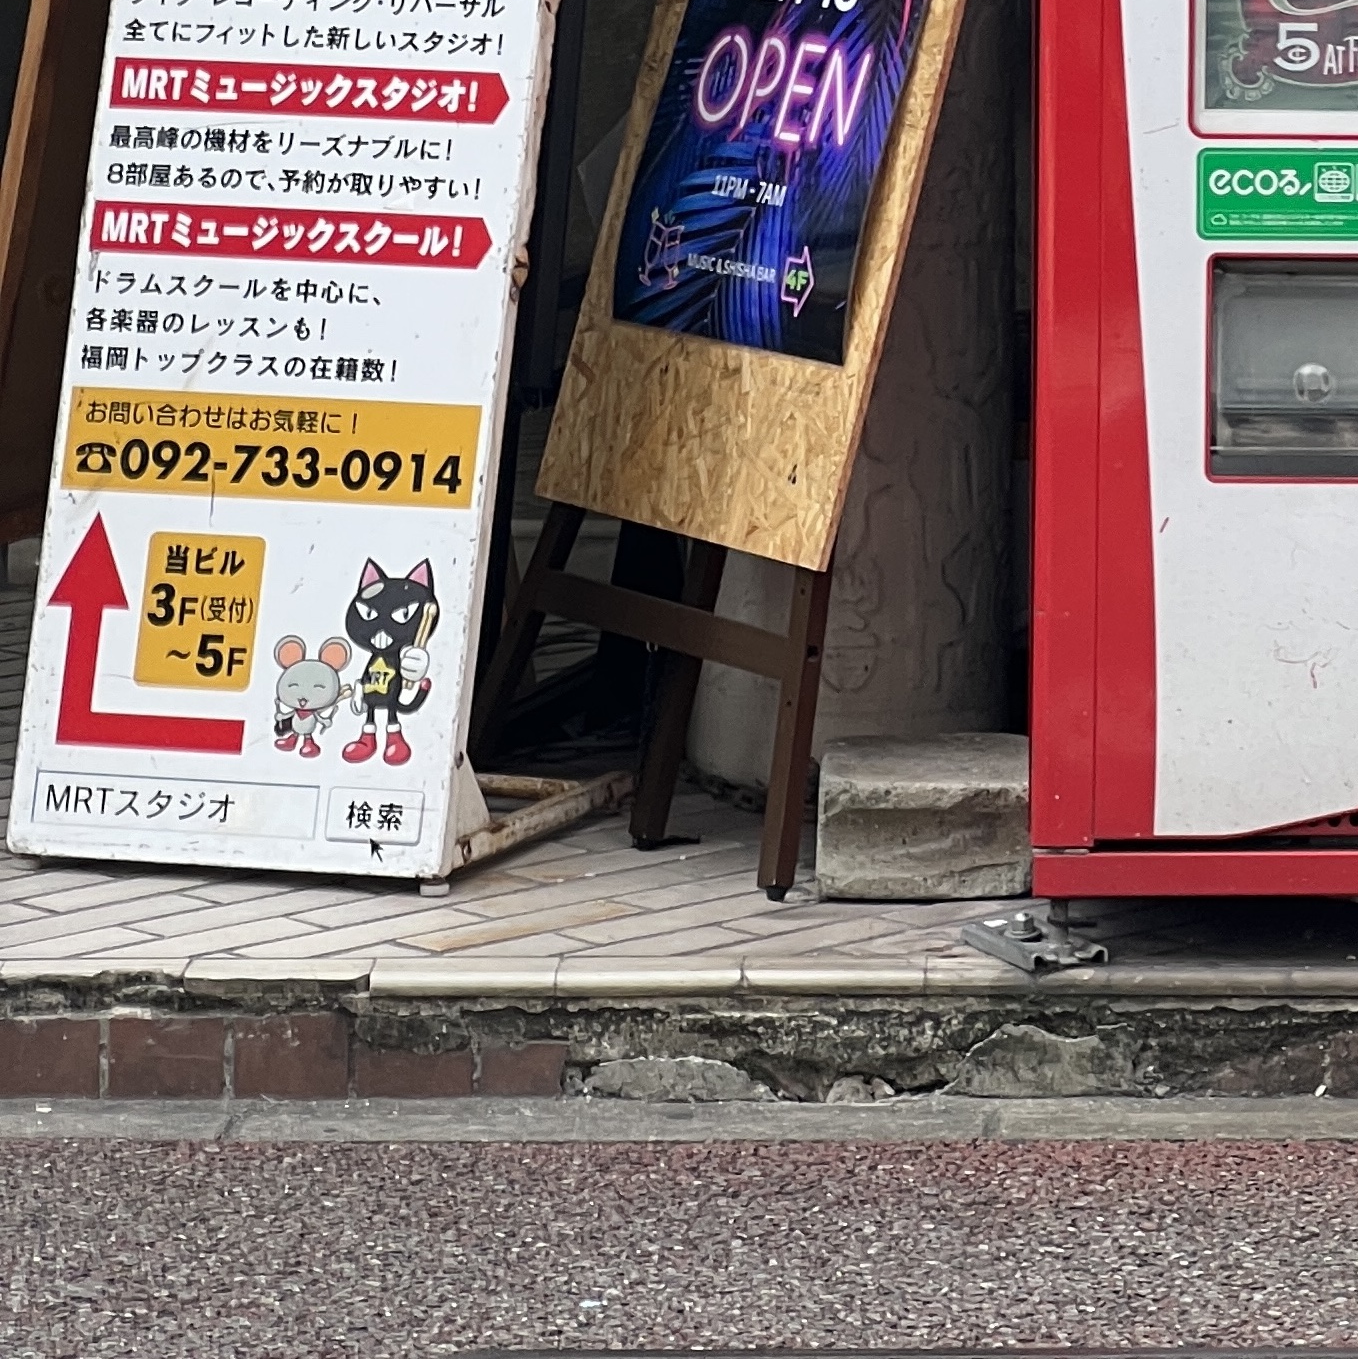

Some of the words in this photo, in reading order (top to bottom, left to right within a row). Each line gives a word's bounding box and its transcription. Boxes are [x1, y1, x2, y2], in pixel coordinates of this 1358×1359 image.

[122, 18, 506, 56] 全てにフィットした新しいスタジオ!
[1323, 51, 1346, 77] AT
[120, 66, 479, 113] MRTミュージックスタジオ!
[696, 33, 873, 147] OPEN
[109, 124, 453, 163] 最高峰の機材をリーズナブルに!
[106, 162, 482, 201] 8部屋あるので、予約が取りやすい!
[711, 174, 749, 200] 11PM
[755, 181, 788, 207] 7AM
[101, 212, 463, 257] MRTミュージックスクール!
[687, 252, 716, 273] MUSIC
[785, 269, 809, 291] 4F
[92, 269, 384, 307] ドラムスクールを中心に、
[84, 308, 327, 342] 各楽器のレッスンも!
[80, 345, 398, 384] 福岡トップクラスの在籍数!
[85, 400, 359, 436] お問い合わせはお気軽に!
[119, 439, 463, 494] 092-733-0914
[164, 546, 245, 577] 当ビル
[146, 583, 255, 628] 3F(受付)
[46, 784, 236, 824] MRTスタジオ
[345, 800, 404, 832] 検索
